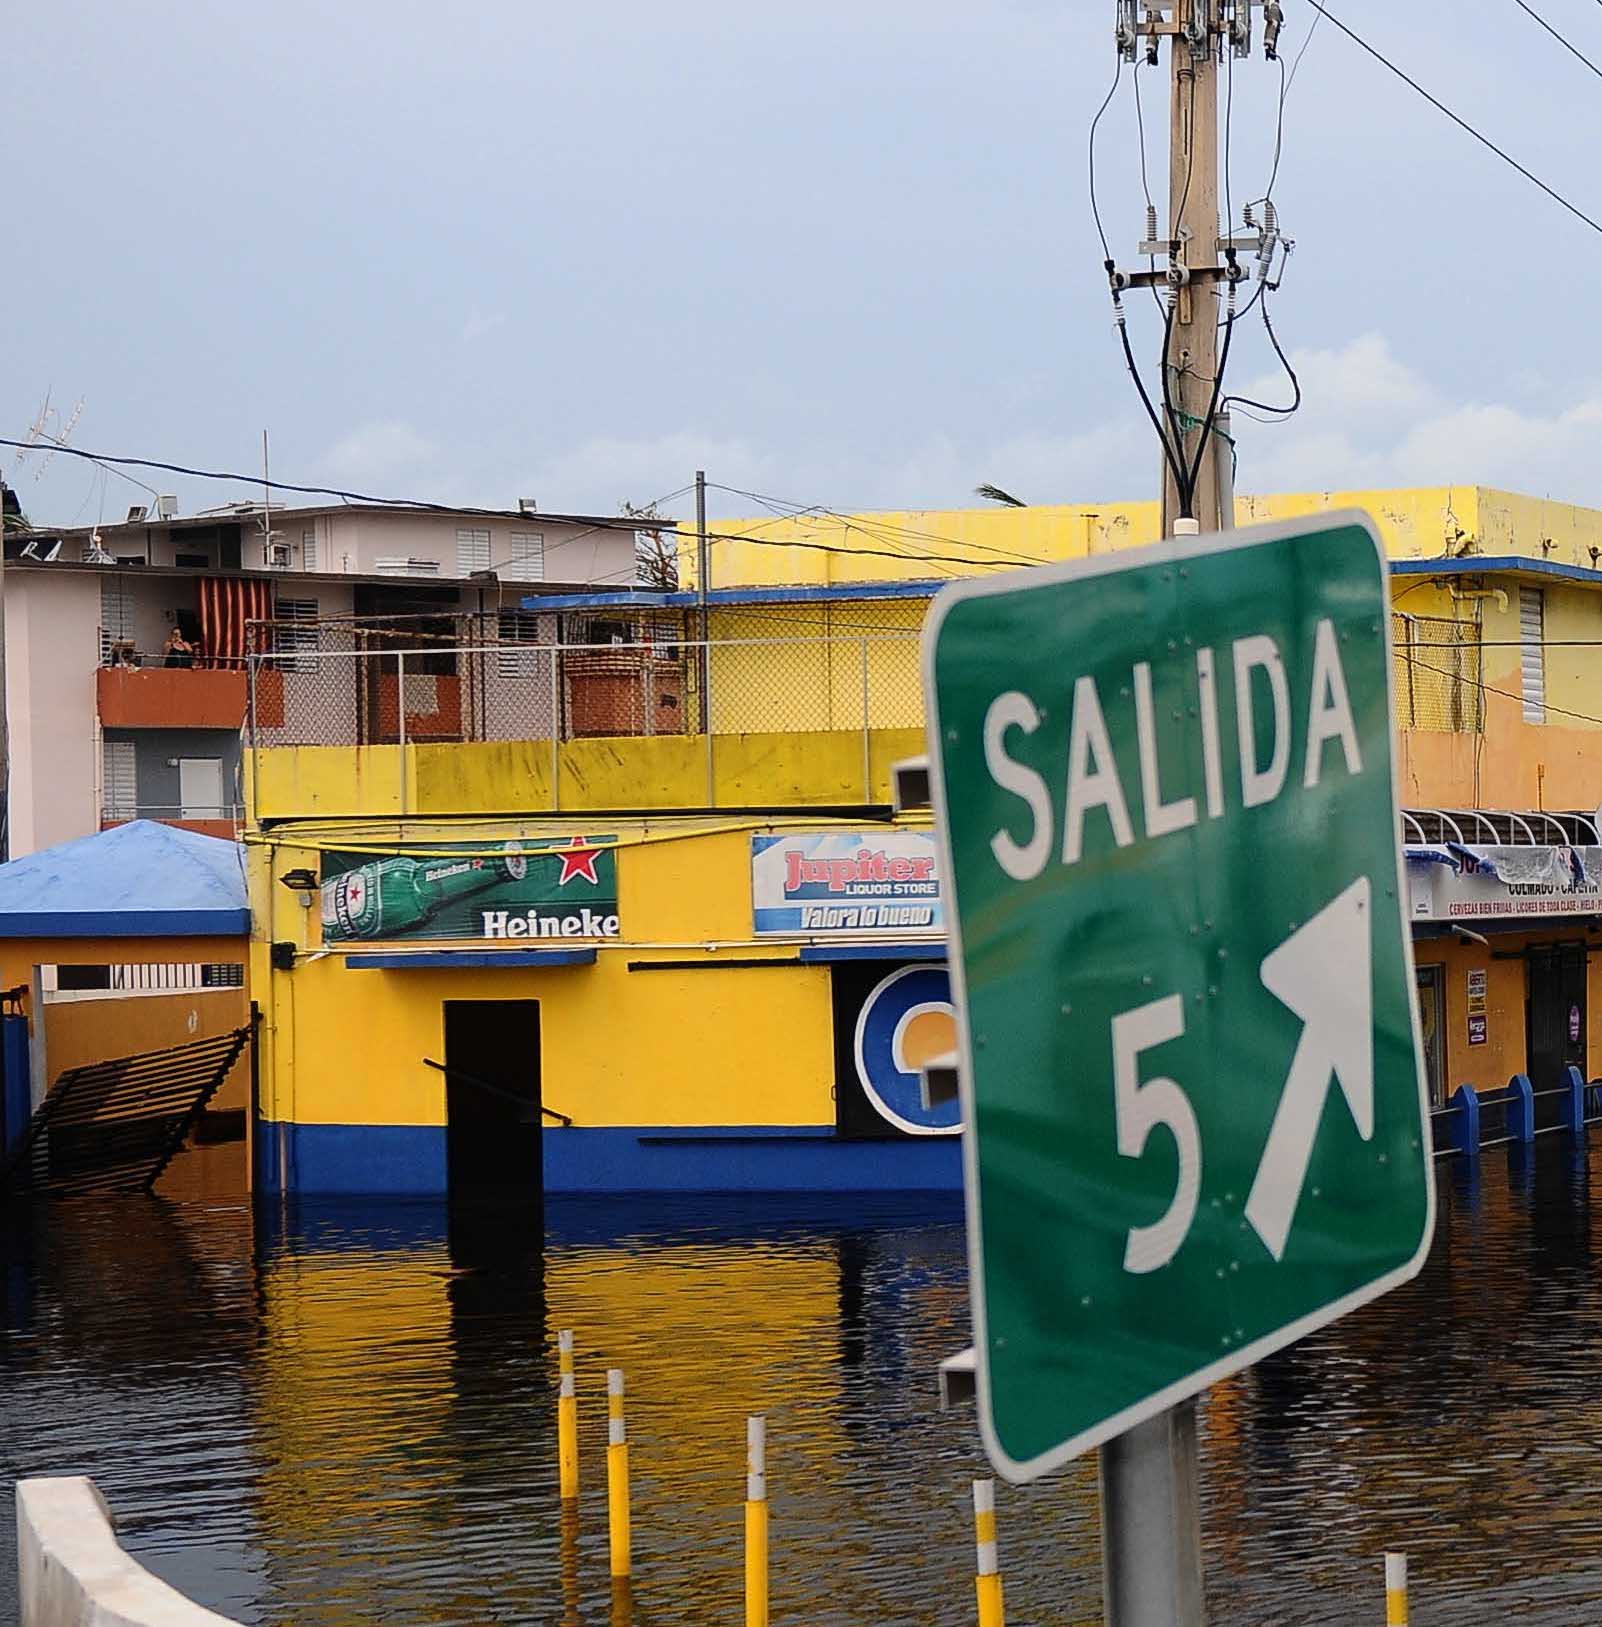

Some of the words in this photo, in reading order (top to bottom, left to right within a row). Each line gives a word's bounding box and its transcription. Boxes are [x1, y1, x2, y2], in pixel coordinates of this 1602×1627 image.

[984, 618, 1364, 882] SALIDA
[784, 850, 935, 892] Jupiter
[845, 883, 892, 895] LIQUOR
[893, 882, 937, 894] STORE
[801, 905, 859, 928] Valora
[859, 906, 877, 926] lo
[877, 905, 932, 926] bueno
[1111, 993, 1200, 1275] 5
